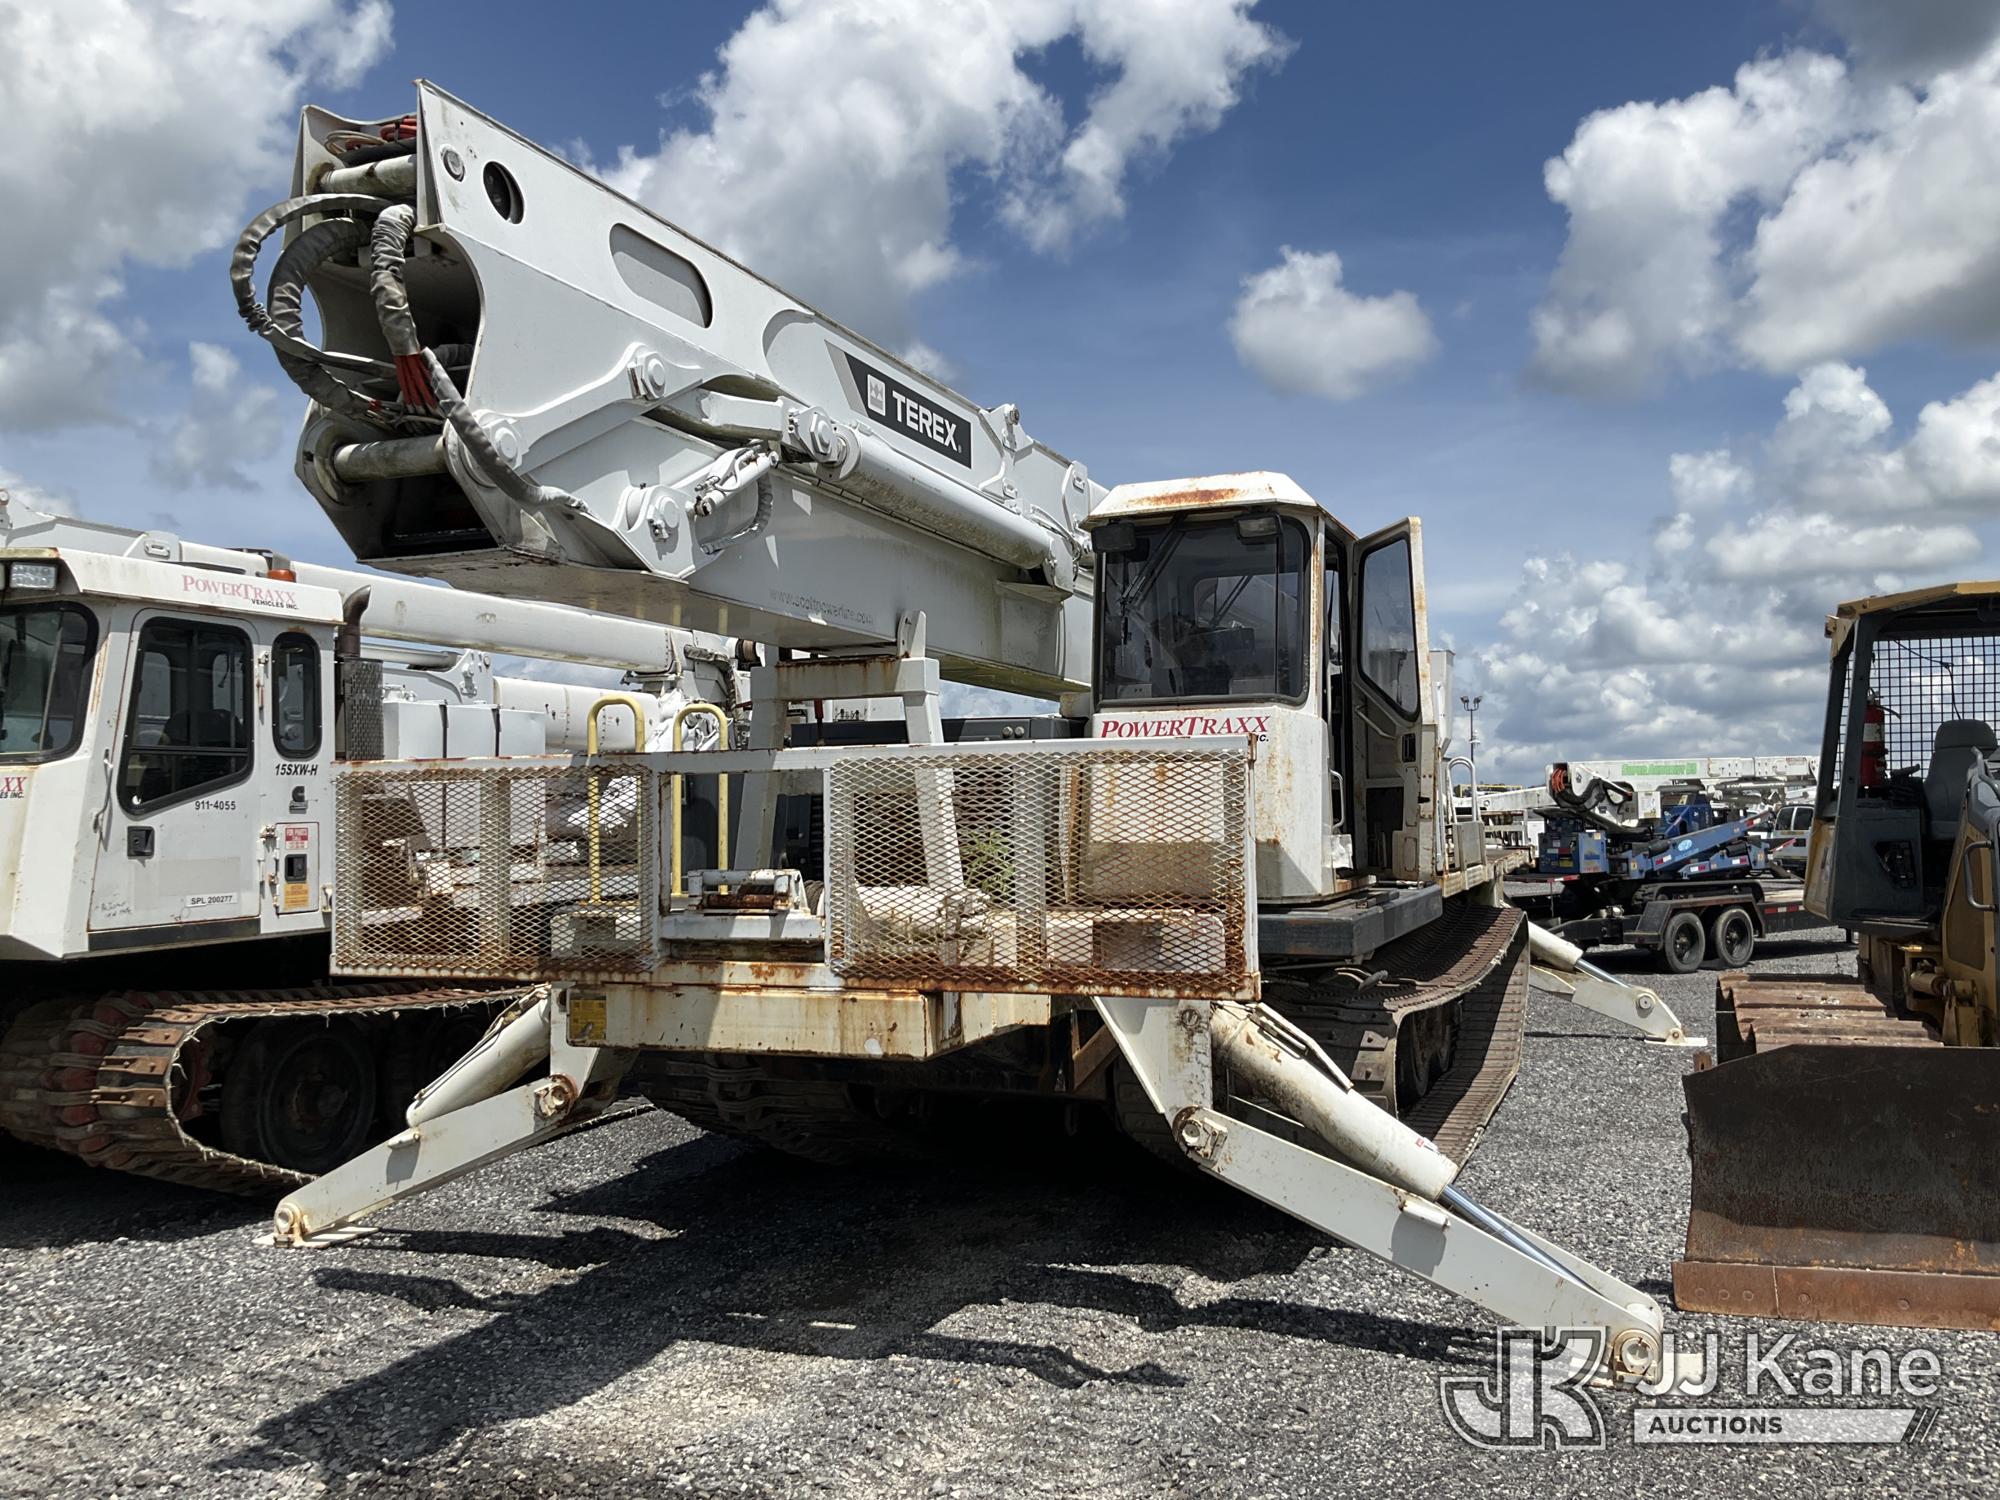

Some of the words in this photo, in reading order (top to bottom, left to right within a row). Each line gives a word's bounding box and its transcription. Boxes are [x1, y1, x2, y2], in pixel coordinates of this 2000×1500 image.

[892, 390, 957, 452] TEREX
[251, 599, 284, 608] VEHICLES
[275, 764, 318, 776] 15SXW-H
[195, 800, 236, 810] 911-4055
[191, 897, 206, 905] SPL
[207, 895, 233, 904] 200277
